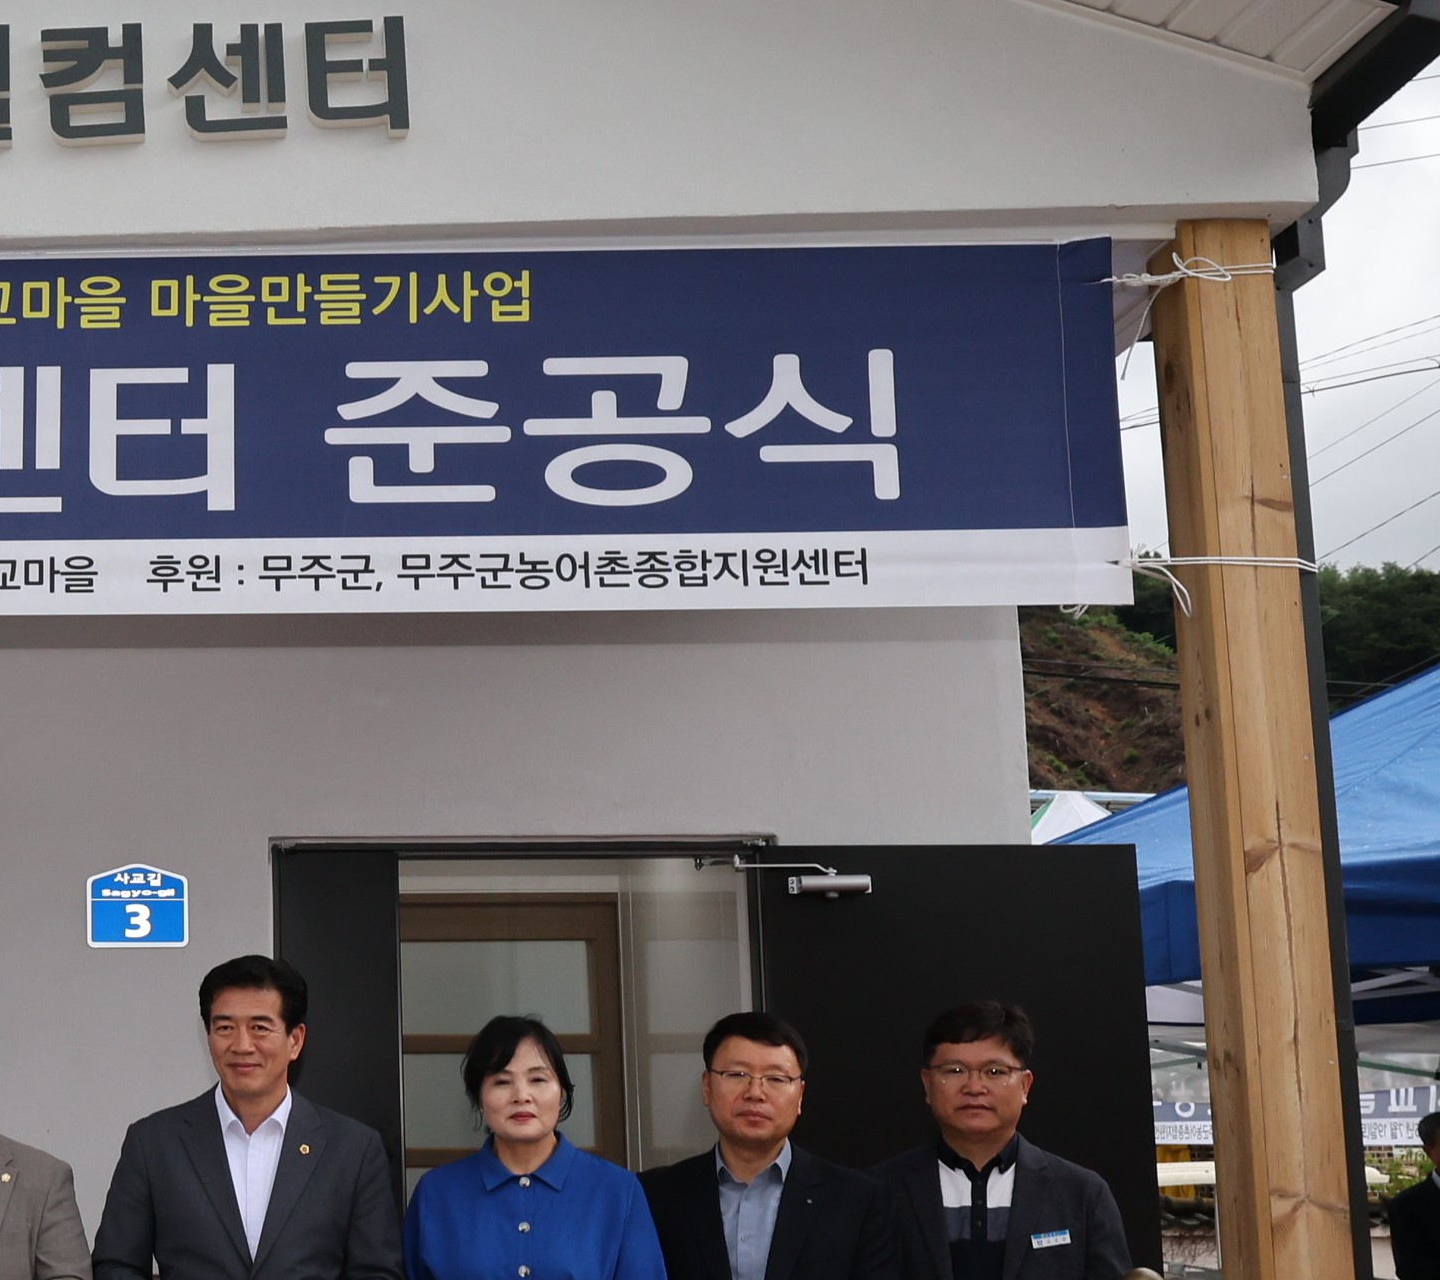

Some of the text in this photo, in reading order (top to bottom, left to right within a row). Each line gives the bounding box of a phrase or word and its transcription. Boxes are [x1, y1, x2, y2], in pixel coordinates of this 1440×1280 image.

[150, 270, 530, 328] 마을만들기사업
[324, 348, 901, 507] 준공식
[146, 554, 221, 593] 후원
[258, 555, 382, 592] 무주군,
[397, 547, 868, 591] 무주군농어촌종합지원센터
[114, 872, 162, 887] 사교길
[124, 903, 152, 938] 3
